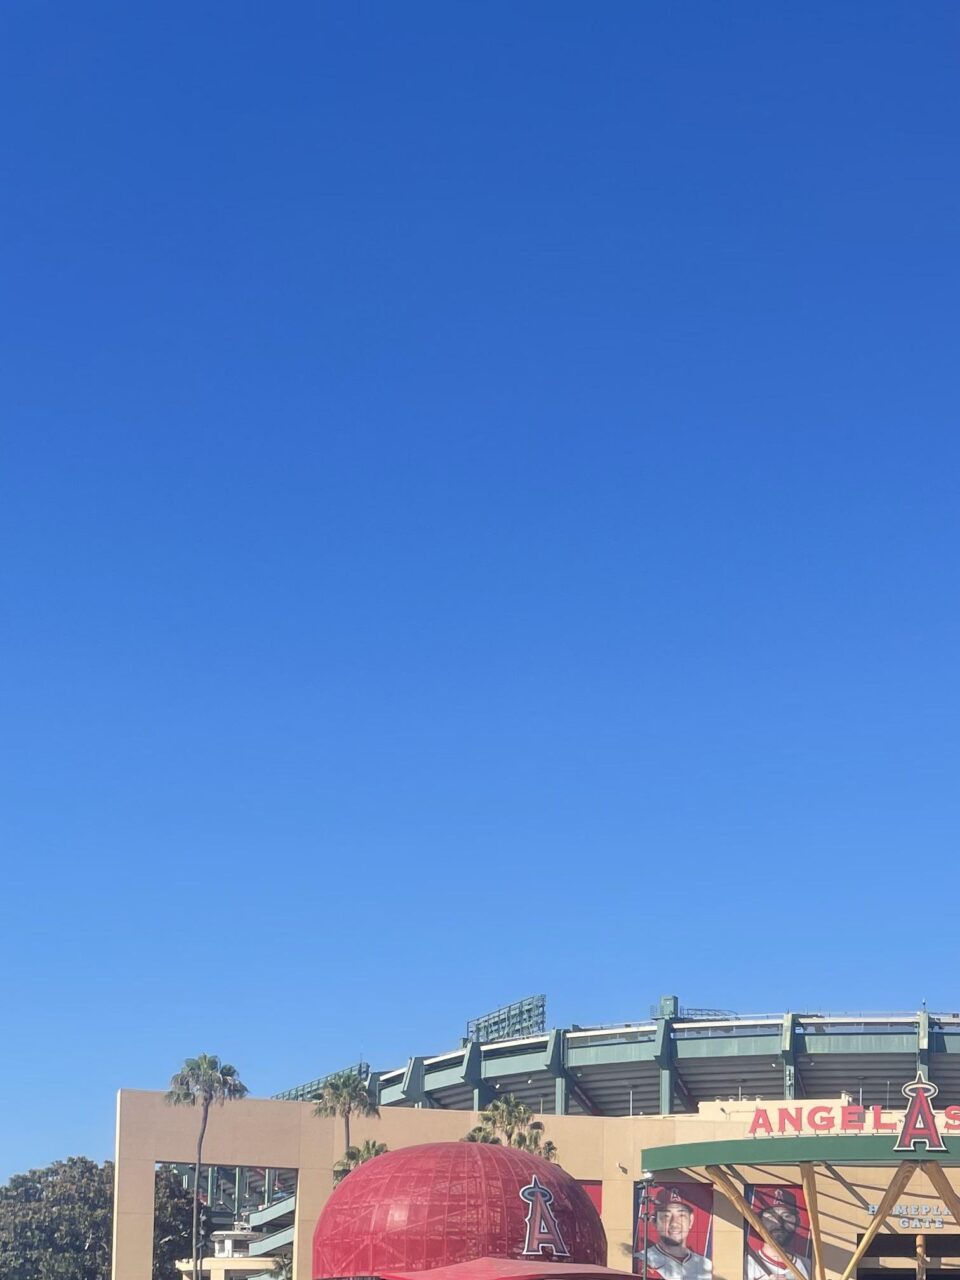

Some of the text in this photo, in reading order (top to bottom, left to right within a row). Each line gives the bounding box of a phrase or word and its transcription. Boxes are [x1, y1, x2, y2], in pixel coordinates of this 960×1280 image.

[749, 1105, 898, 1134] ANGEL
[893, 1071, 947, 1151] A
[519, 1174, 570, 1257] A
[900, 1218, 944, 1229] GATE
